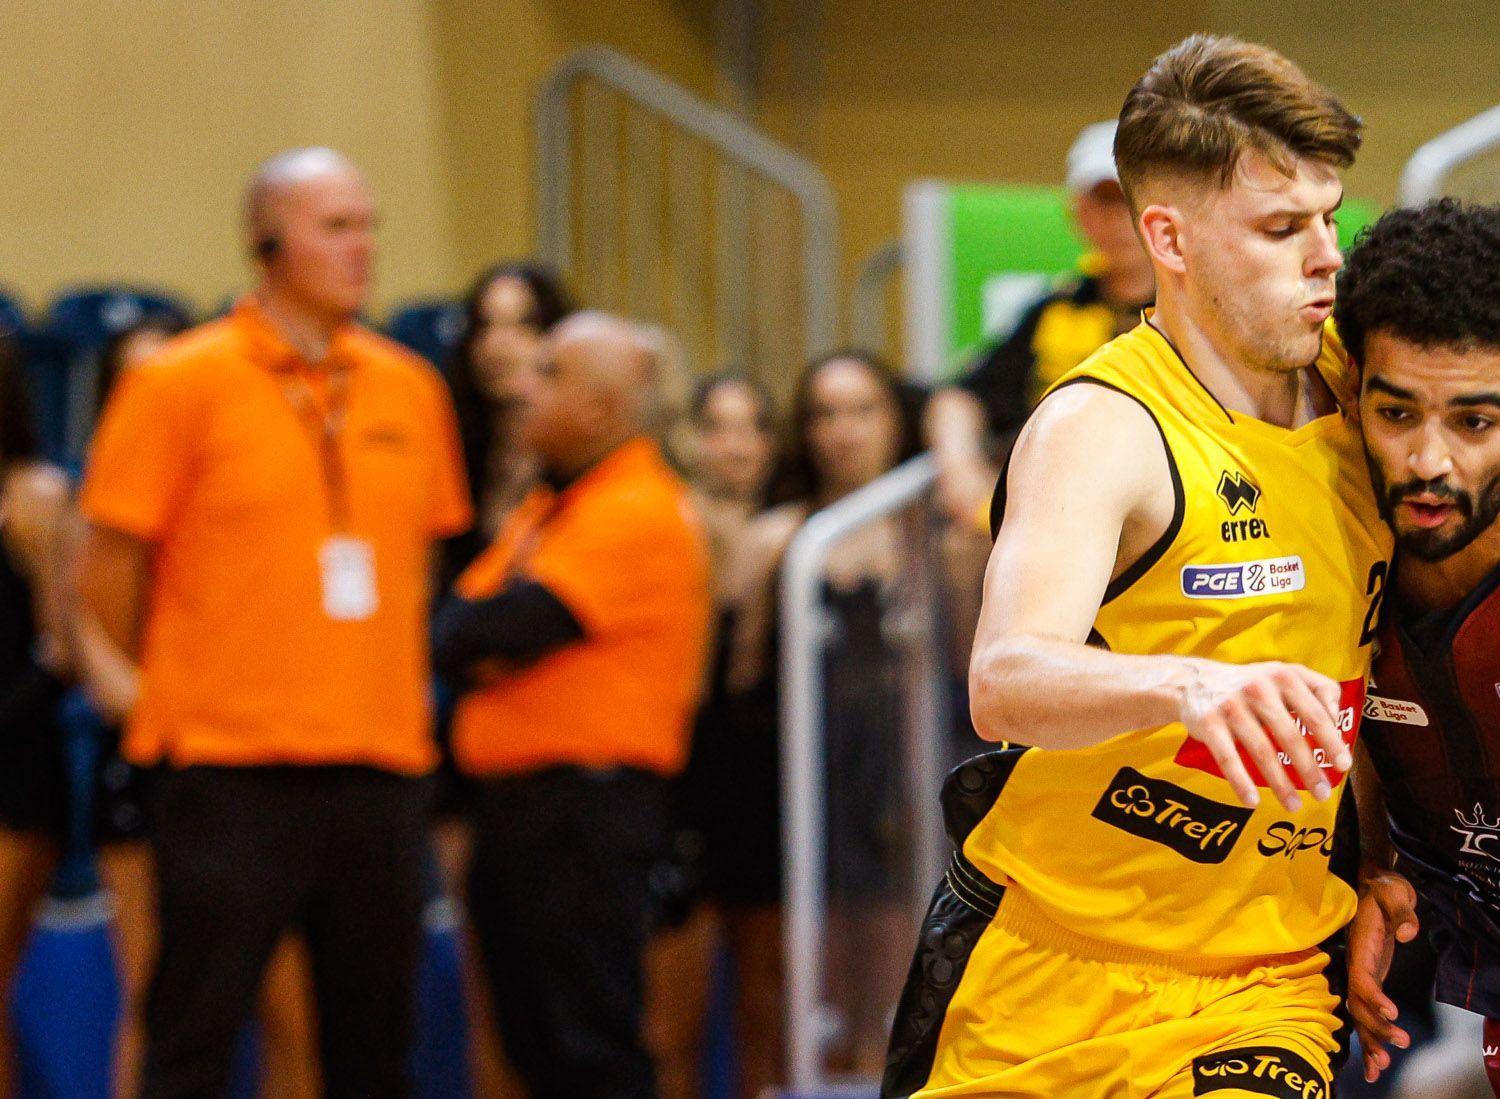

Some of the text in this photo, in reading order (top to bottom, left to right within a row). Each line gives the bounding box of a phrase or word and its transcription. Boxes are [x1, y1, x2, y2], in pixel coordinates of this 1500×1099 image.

[1269, 562, 1300, 574] Basket
[1192, 572, 1240, 591] PGE
[1271, 577, 1292, 589] Liga
[1380, 700, 1417, 714] Basket
[1384, 710, 1407, 721] Liga
[1155, 798, 1238, 851] Trefl
[1253, 1055, 1324, 1099] Trefl
